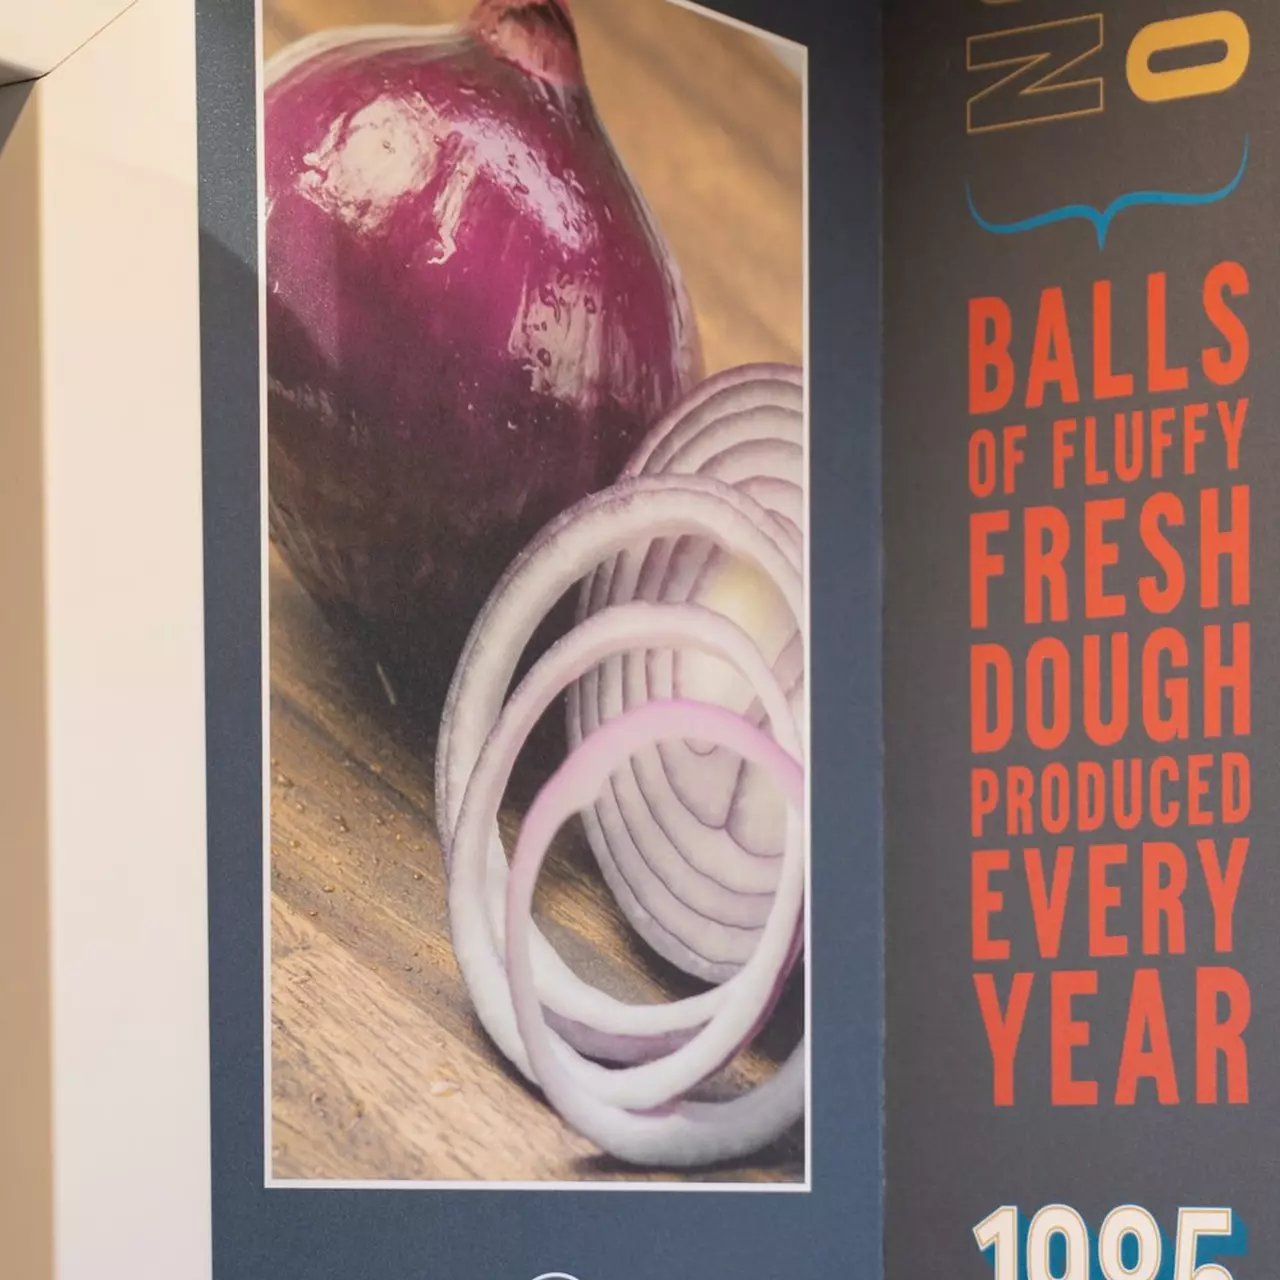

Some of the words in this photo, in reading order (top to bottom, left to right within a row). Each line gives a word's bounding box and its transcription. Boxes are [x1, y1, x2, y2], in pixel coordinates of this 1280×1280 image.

[968, 261, 1250, 414] BALLS
[969, 424, 1026, 498] OF
[1052, 399, 1249, 490] FLUFFY
[970, 485, 1250, 629] FRESH
[970, 622, 1250, 753] DOUGH
[971, 752, 1251, 837] PRODUCED
[971, 838, 1250, 961] EVERY
[973, 966, 1251, 1107] YEAR
